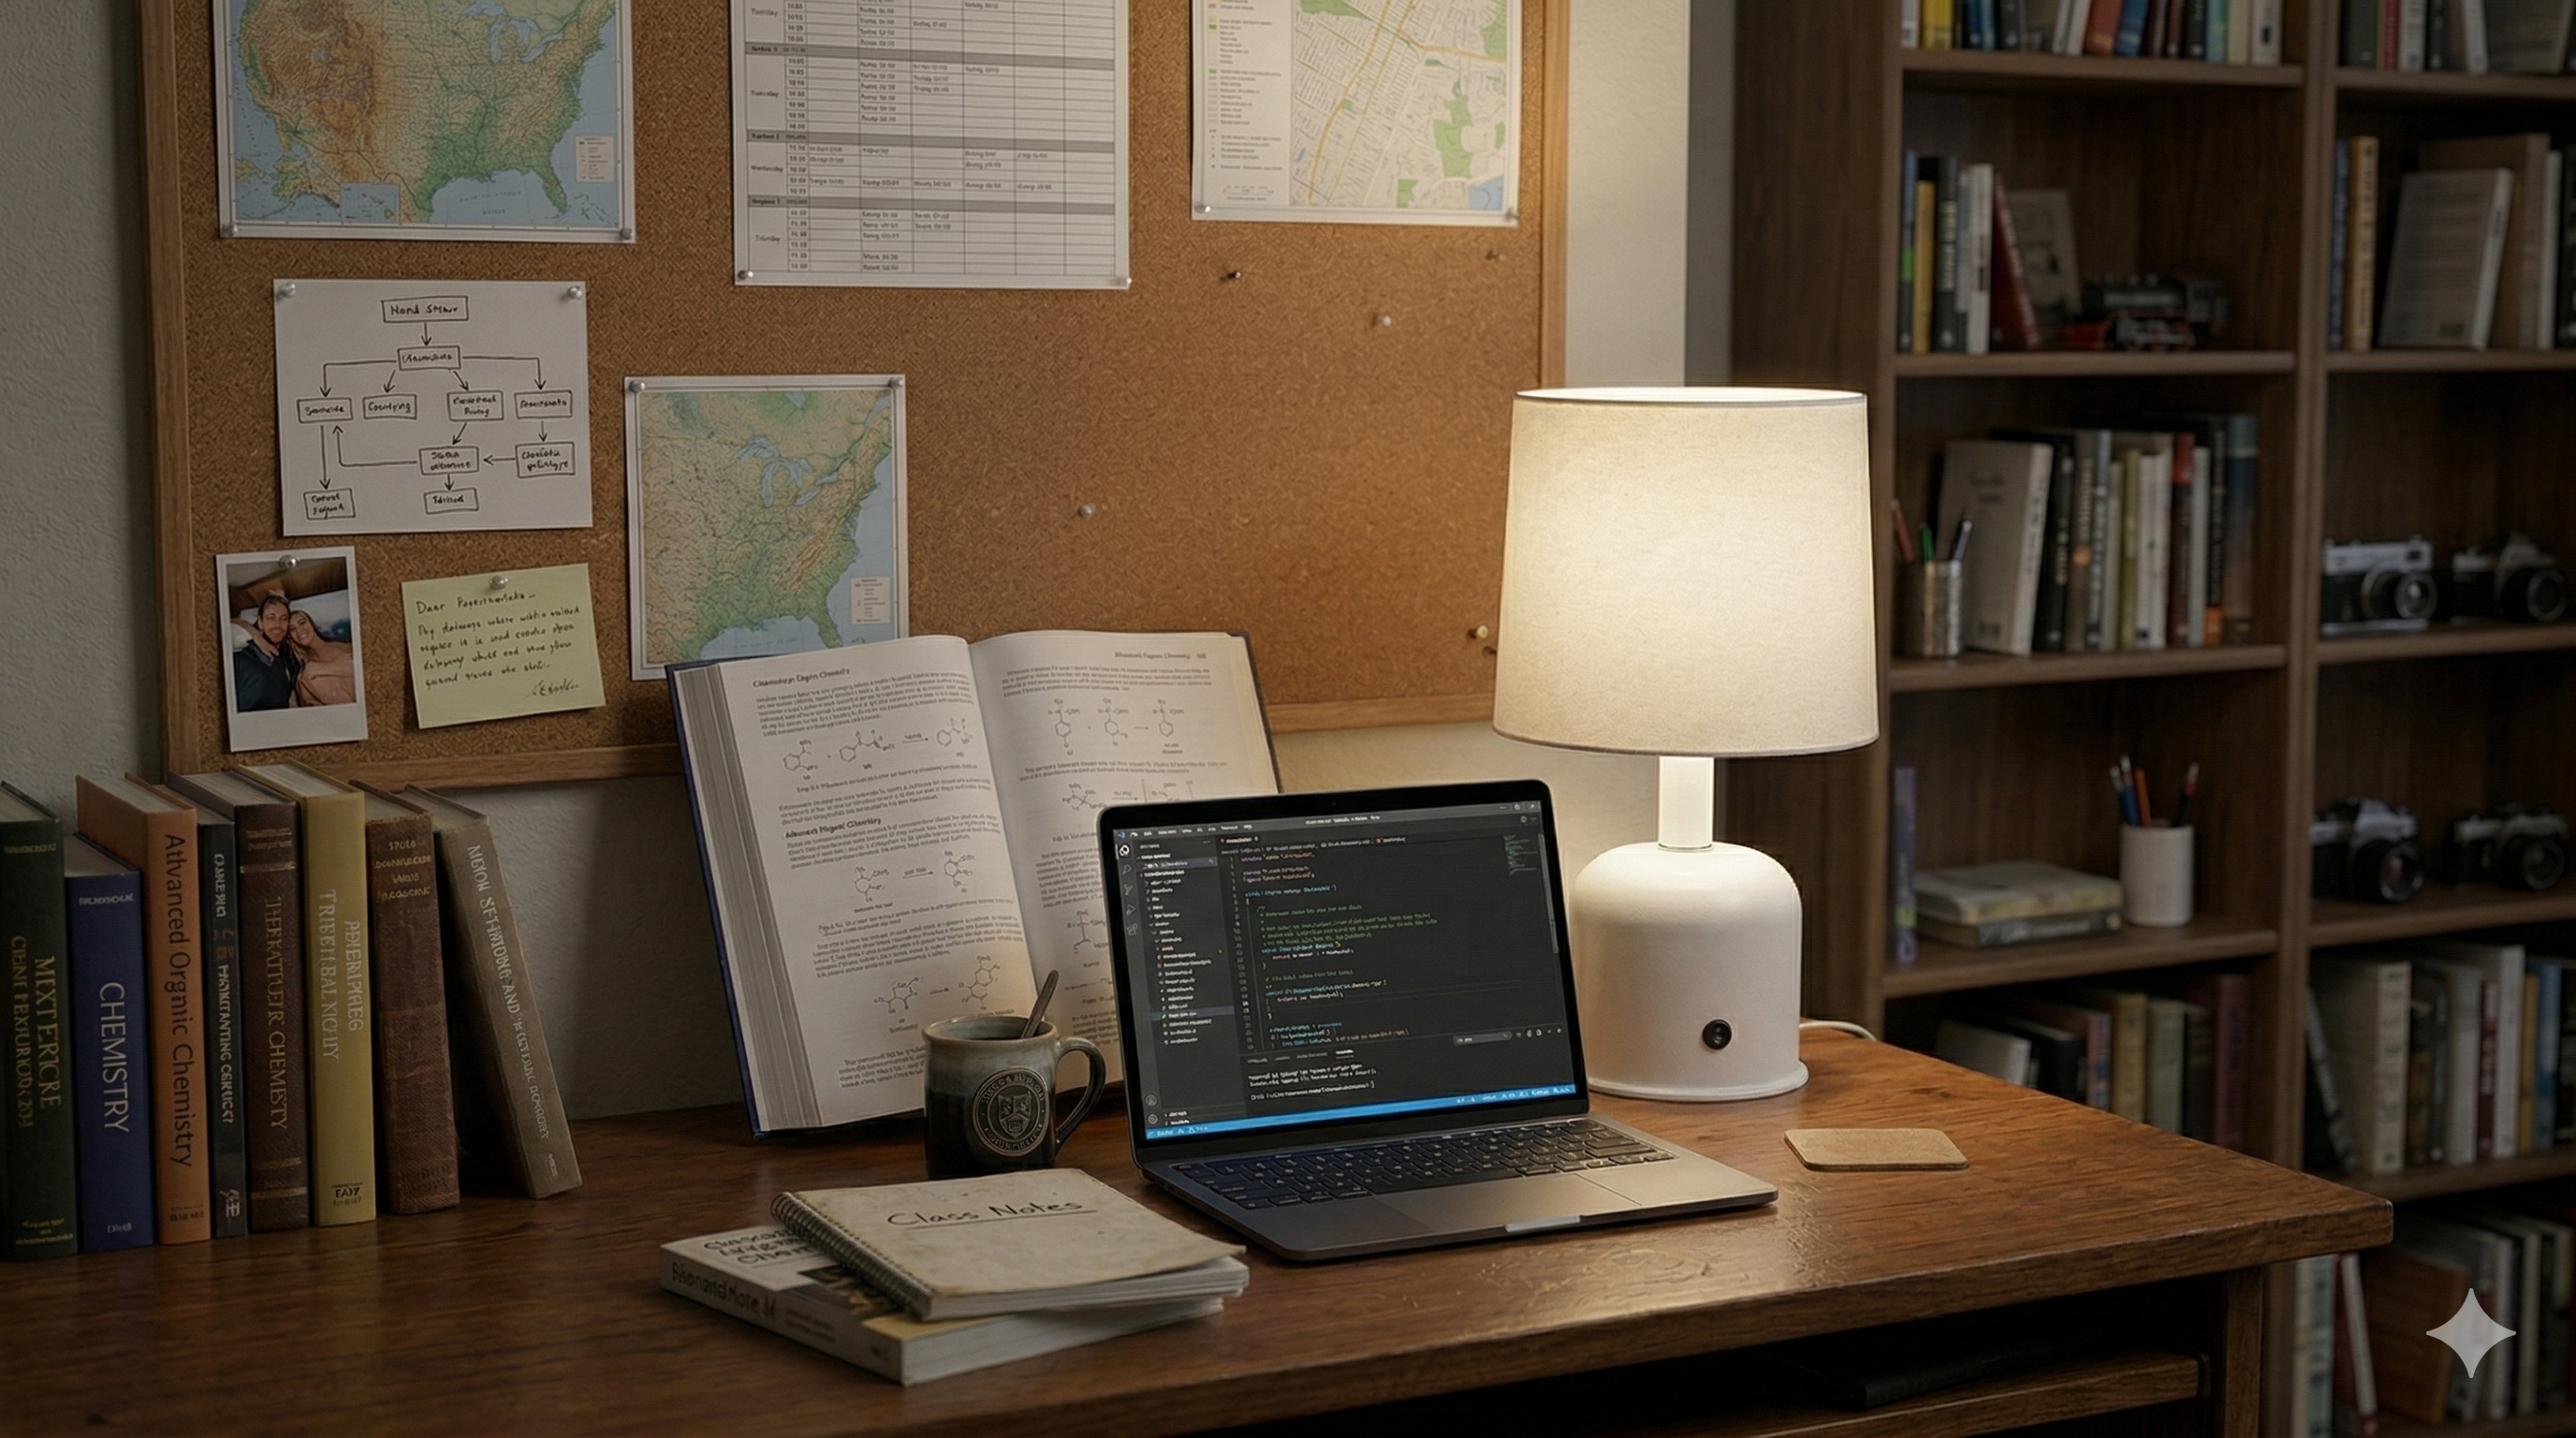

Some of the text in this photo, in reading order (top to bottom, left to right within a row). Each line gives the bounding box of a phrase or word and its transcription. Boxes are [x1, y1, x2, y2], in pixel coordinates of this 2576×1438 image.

[502, 985, 520, 1015] AND
[98, 981, 130, 1134] CHEMISTRY
[169, 1043, 196, 1167] Chemistry
[887, 1202, 1083, 1226] Class Notes
